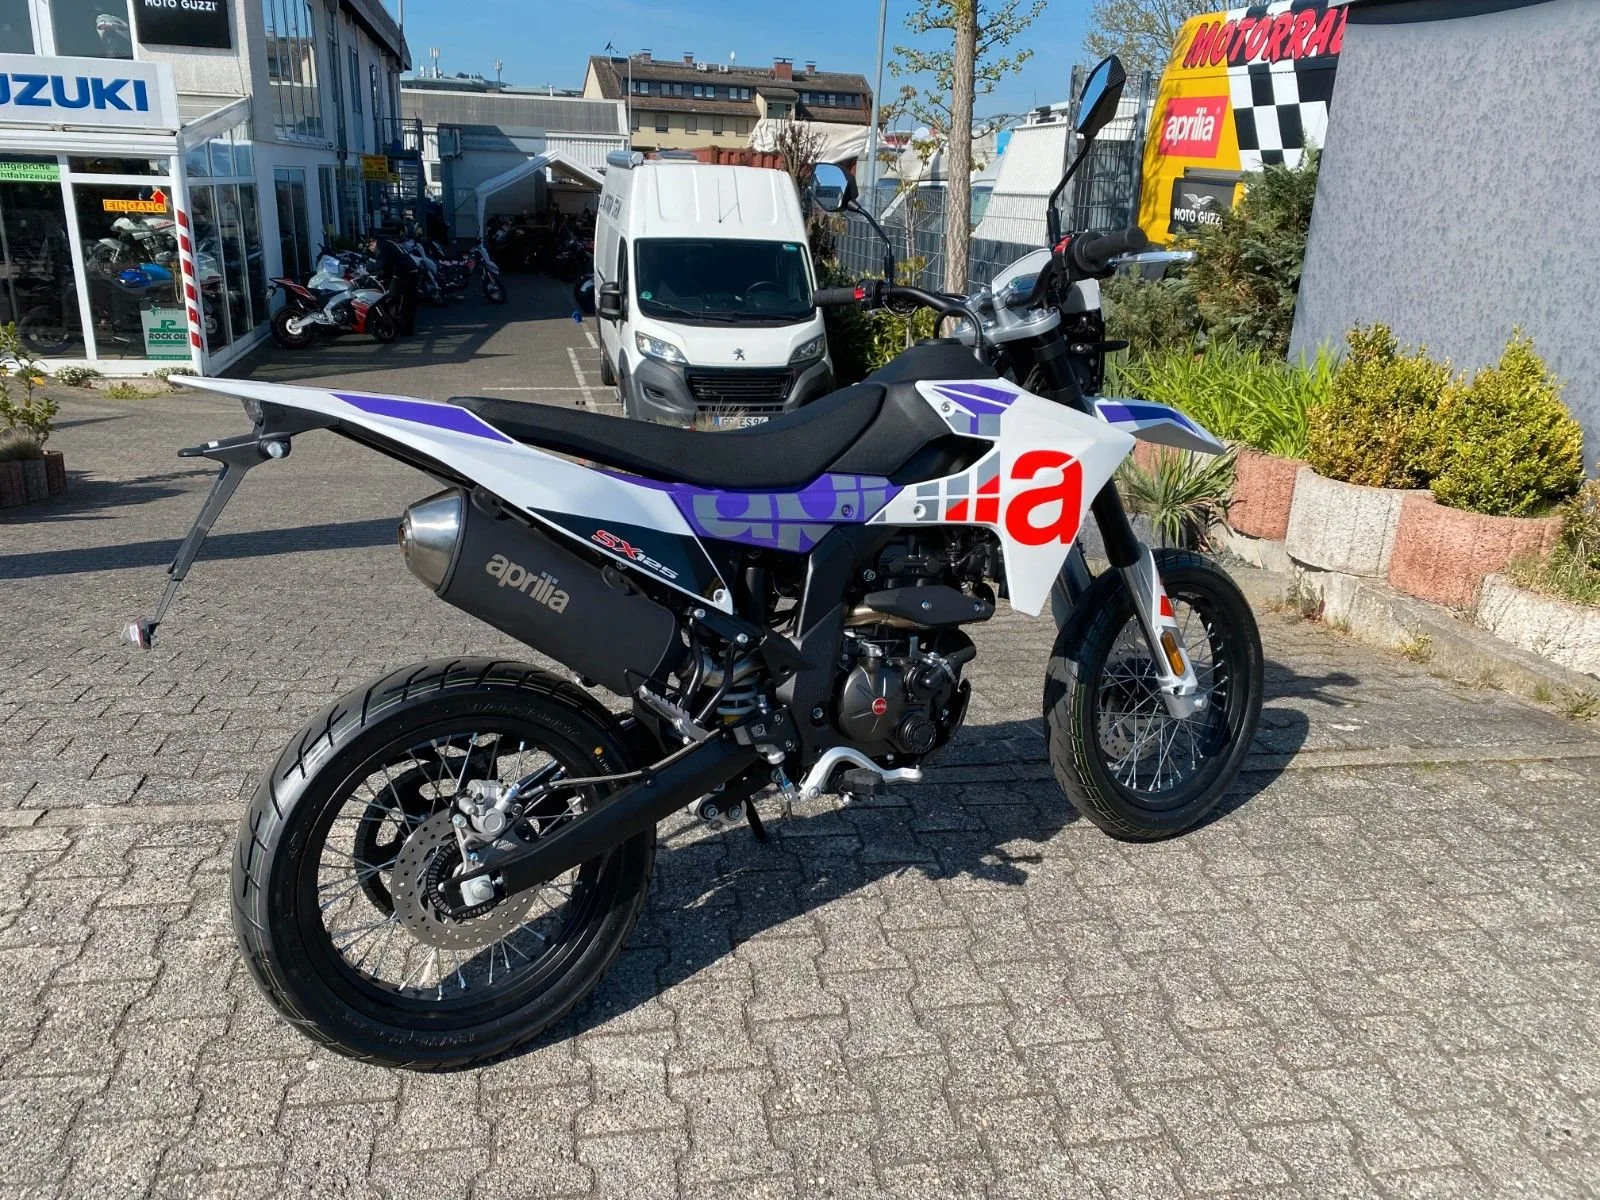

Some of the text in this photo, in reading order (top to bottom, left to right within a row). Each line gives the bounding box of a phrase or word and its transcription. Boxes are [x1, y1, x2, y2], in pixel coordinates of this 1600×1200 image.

[180, 0, 216, 11] GUZZI
[0, 73, 149, 112] ZUKI
[1165, 106, 1216, 147] aprilia
[105, 201, 164, 211] EINGANG
[1174, 207, 1196, 223] MOTO
[1005, 449, 1084, 546] a
[485, 553, 570, 614] aprilia
